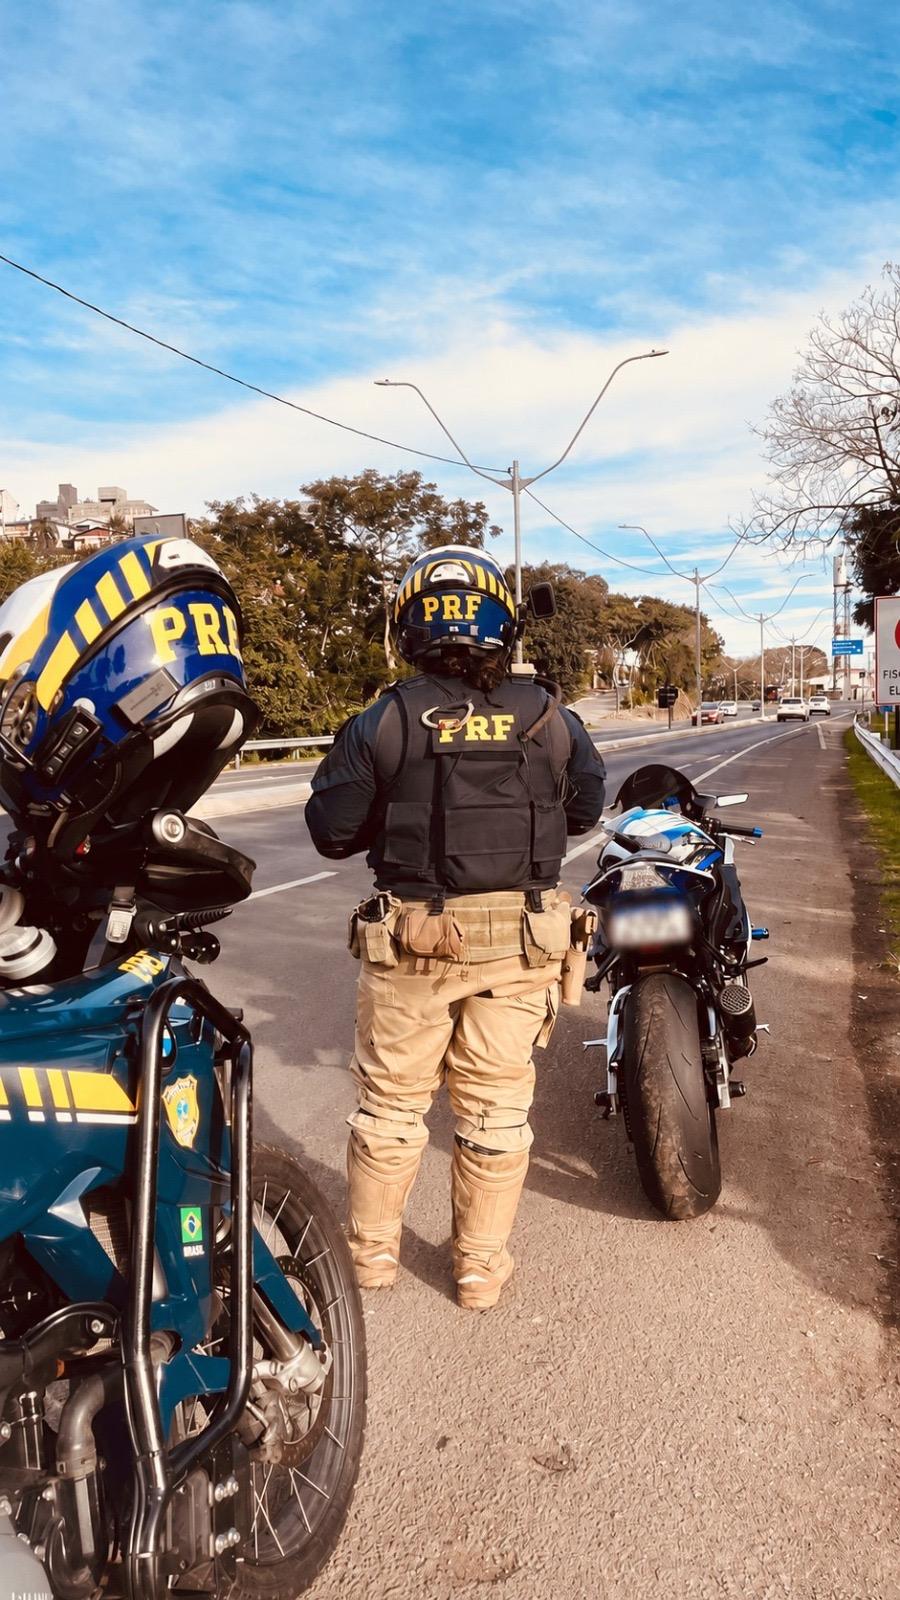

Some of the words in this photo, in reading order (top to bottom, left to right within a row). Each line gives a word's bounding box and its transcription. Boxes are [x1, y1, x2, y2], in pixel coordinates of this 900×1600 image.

[422, 595, 482, 621] PRF
[883, 669, 900, 679] FIS
[439, 715, 514, 743] PRF
